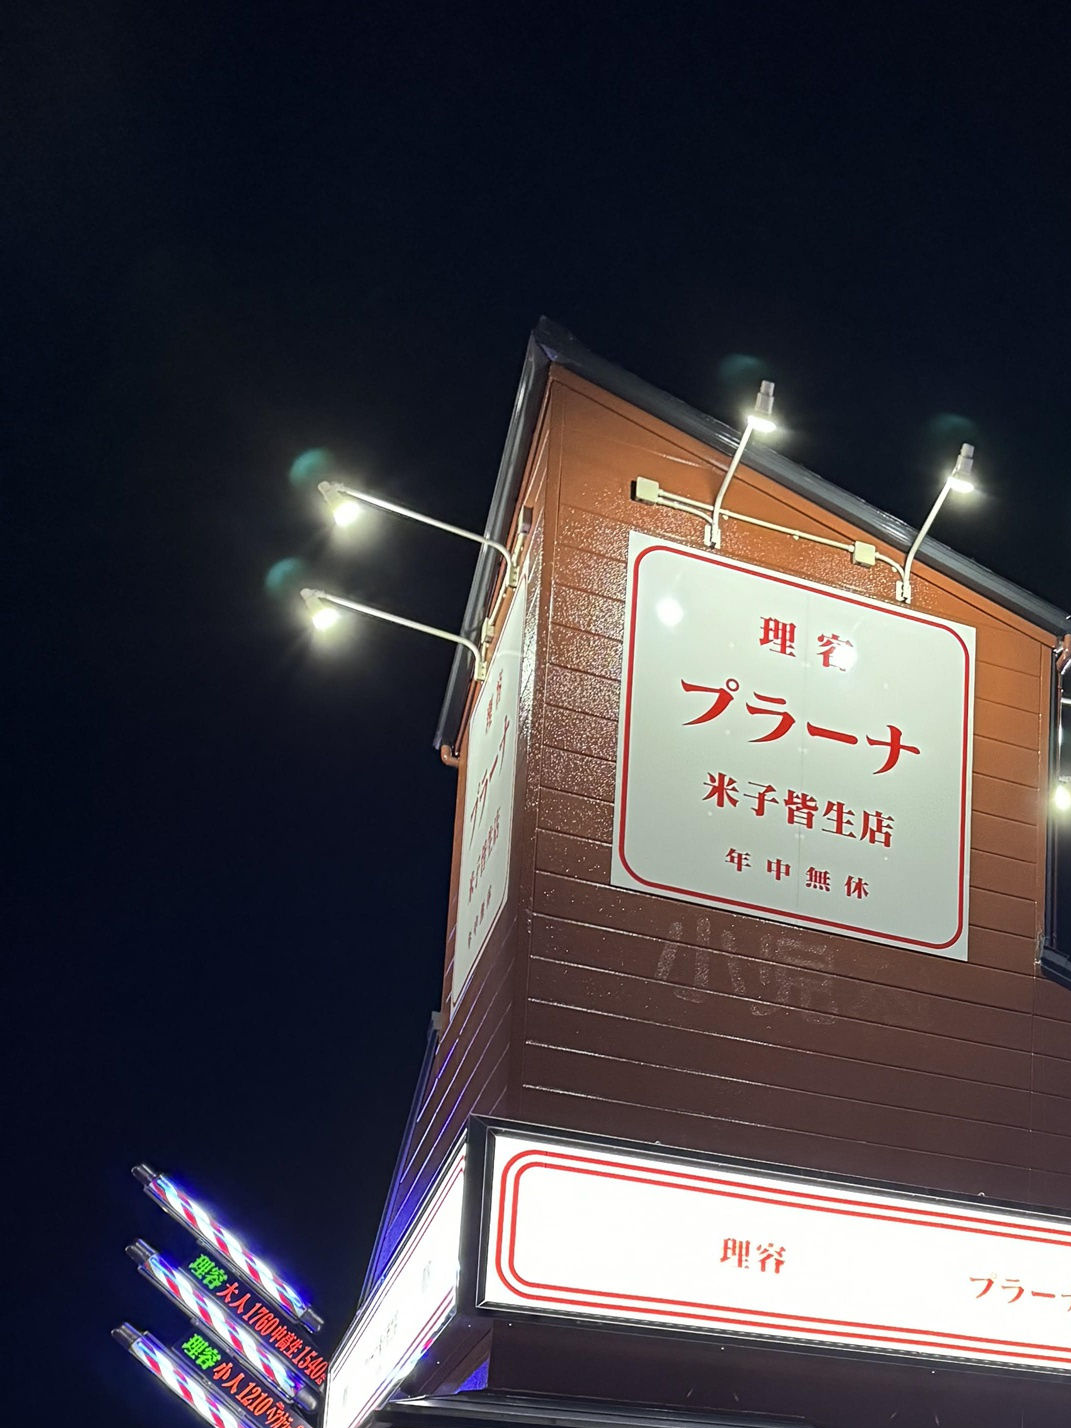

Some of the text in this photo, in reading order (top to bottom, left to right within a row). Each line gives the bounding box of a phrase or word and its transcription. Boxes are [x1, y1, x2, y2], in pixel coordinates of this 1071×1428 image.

[680, 677, 922, 775] プラーナ
[702, 771, 895, 849] 米子皆生店
[724, 847, 870, 900] 年中無休
[188, 1254, 228, 1290] 理容
[719, 1237, 787, 1275] 理容
[181, 1333, 221, 1370] 理容
